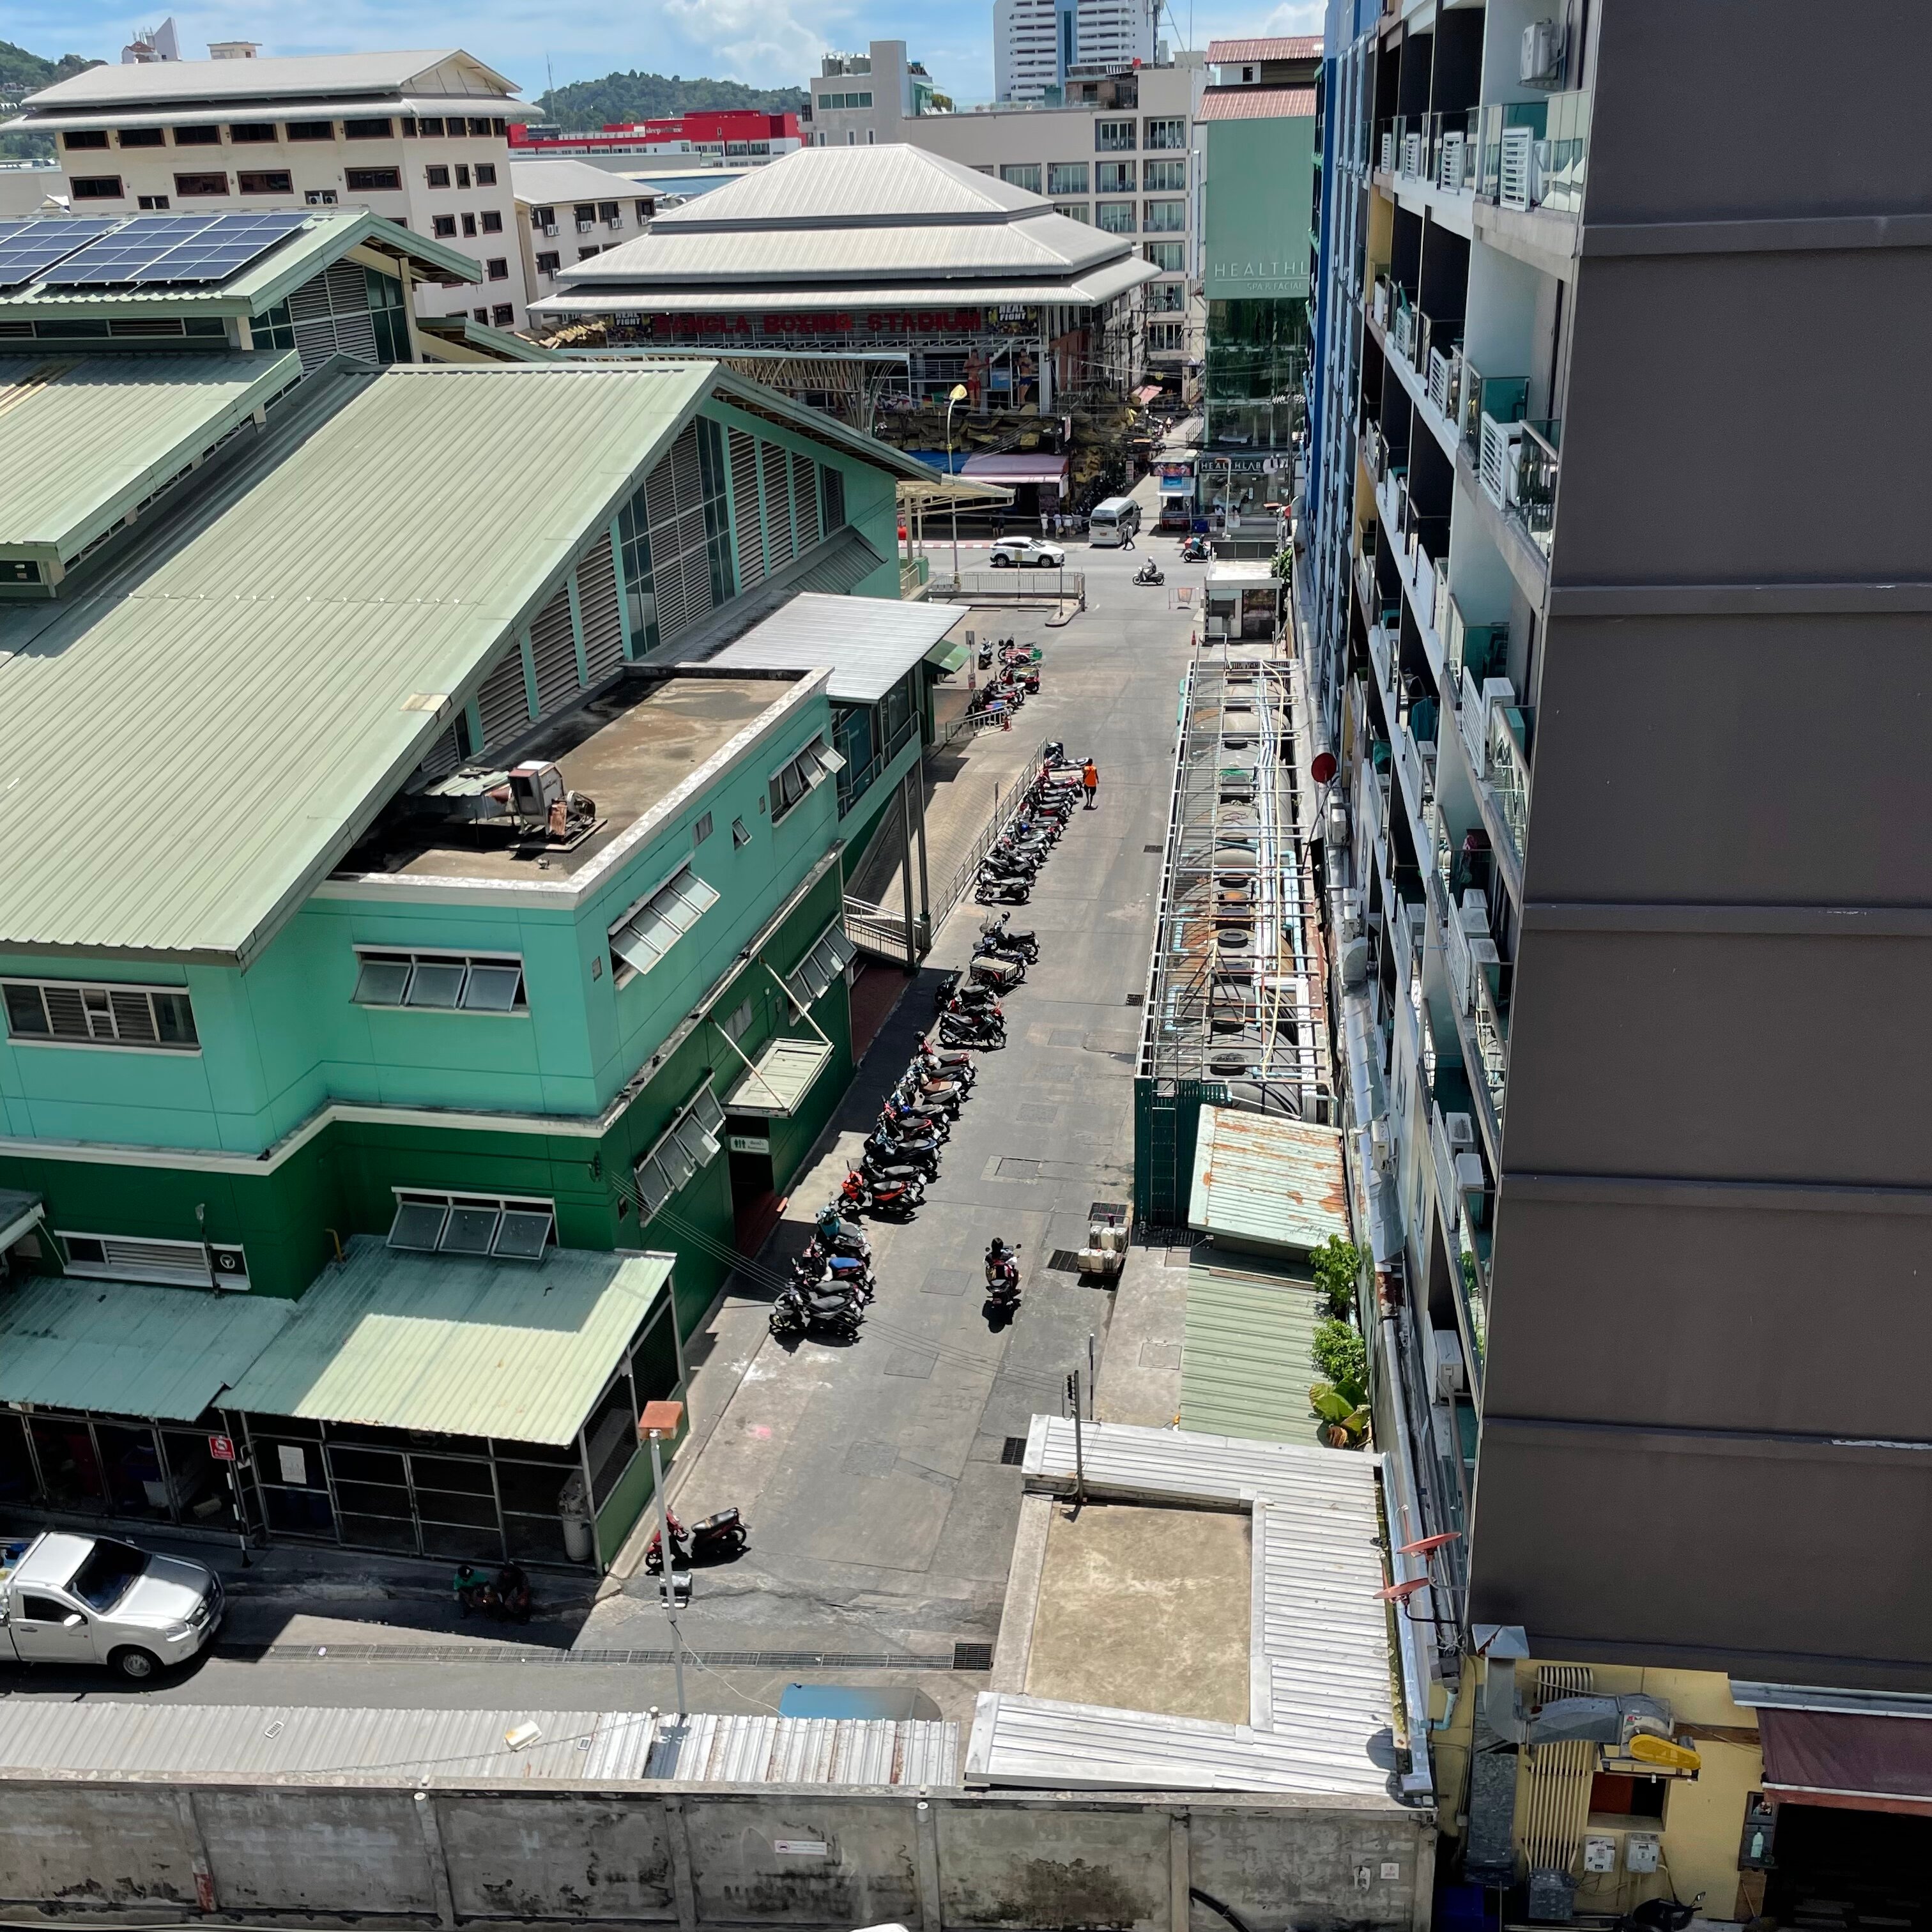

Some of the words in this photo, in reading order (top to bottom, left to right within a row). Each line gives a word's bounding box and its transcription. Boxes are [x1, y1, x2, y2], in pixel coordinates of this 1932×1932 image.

[1246, 282, 1263, 291] SPA
[1273, 282, 1304, 291] FACIAL
[999, 304, 1025, 314] REAL
[1000, 312, 1027, 321] FIGHT
[616, 318, 641, 326] FIGHT
[763, 313, 853, 334] BOXING
[867, 311, 981, 332] STADIUM
